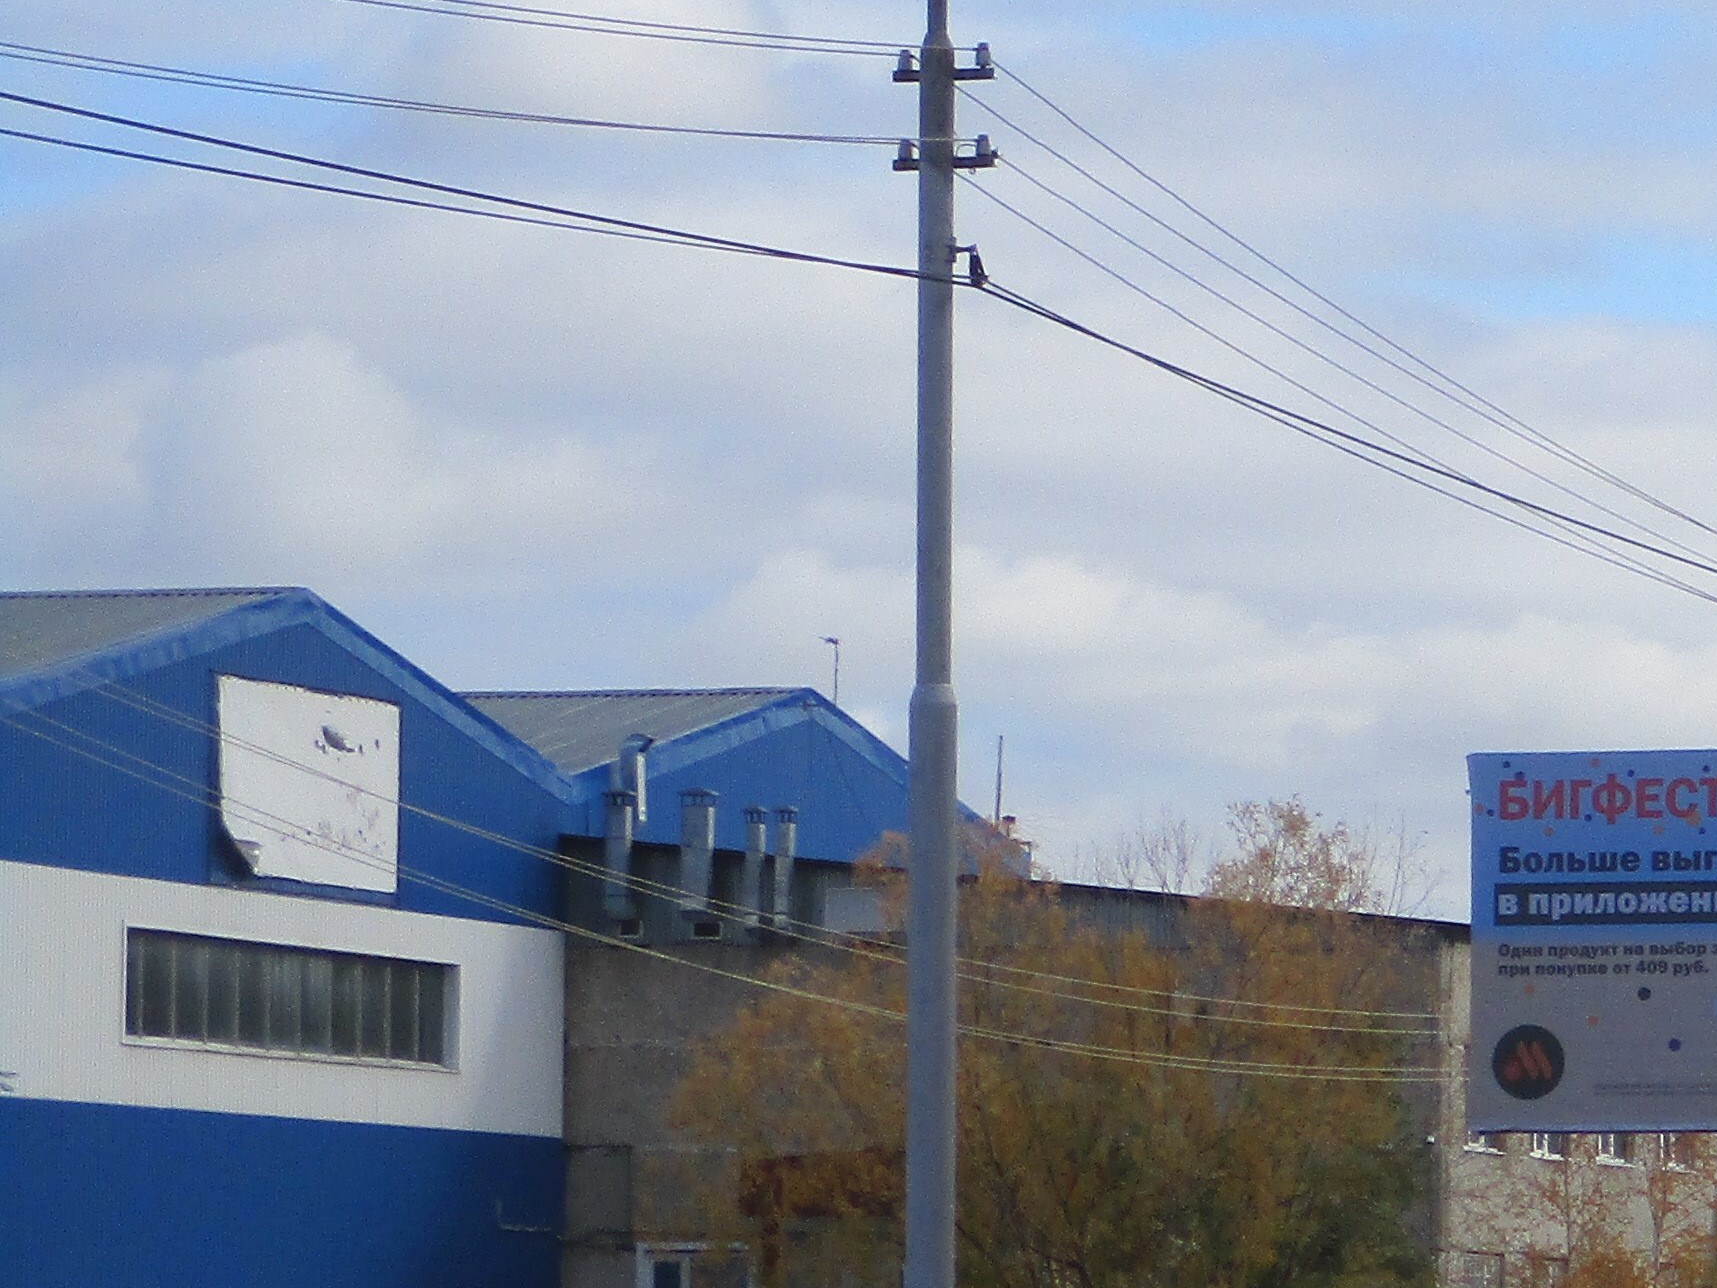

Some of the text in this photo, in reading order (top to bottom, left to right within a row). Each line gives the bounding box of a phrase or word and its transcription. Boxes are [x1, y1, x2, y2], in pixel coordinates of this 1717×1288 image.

[1500, 846, 1640, 874] Больше
[1499, 893, 1518, 915] в
[1499, 944, 1543, 959] Один
[1549, 944, 1618, 960] продукт
[1623, 943, 1644, 957] на
[1650, 941, 1707, 958] выбор
[1499, 964, 1530, 978] при
[1535, 963, 1608, 978] покупке
[1611, 962, 1631, 975] от
[1673, 960, 1709, 976] руб.
